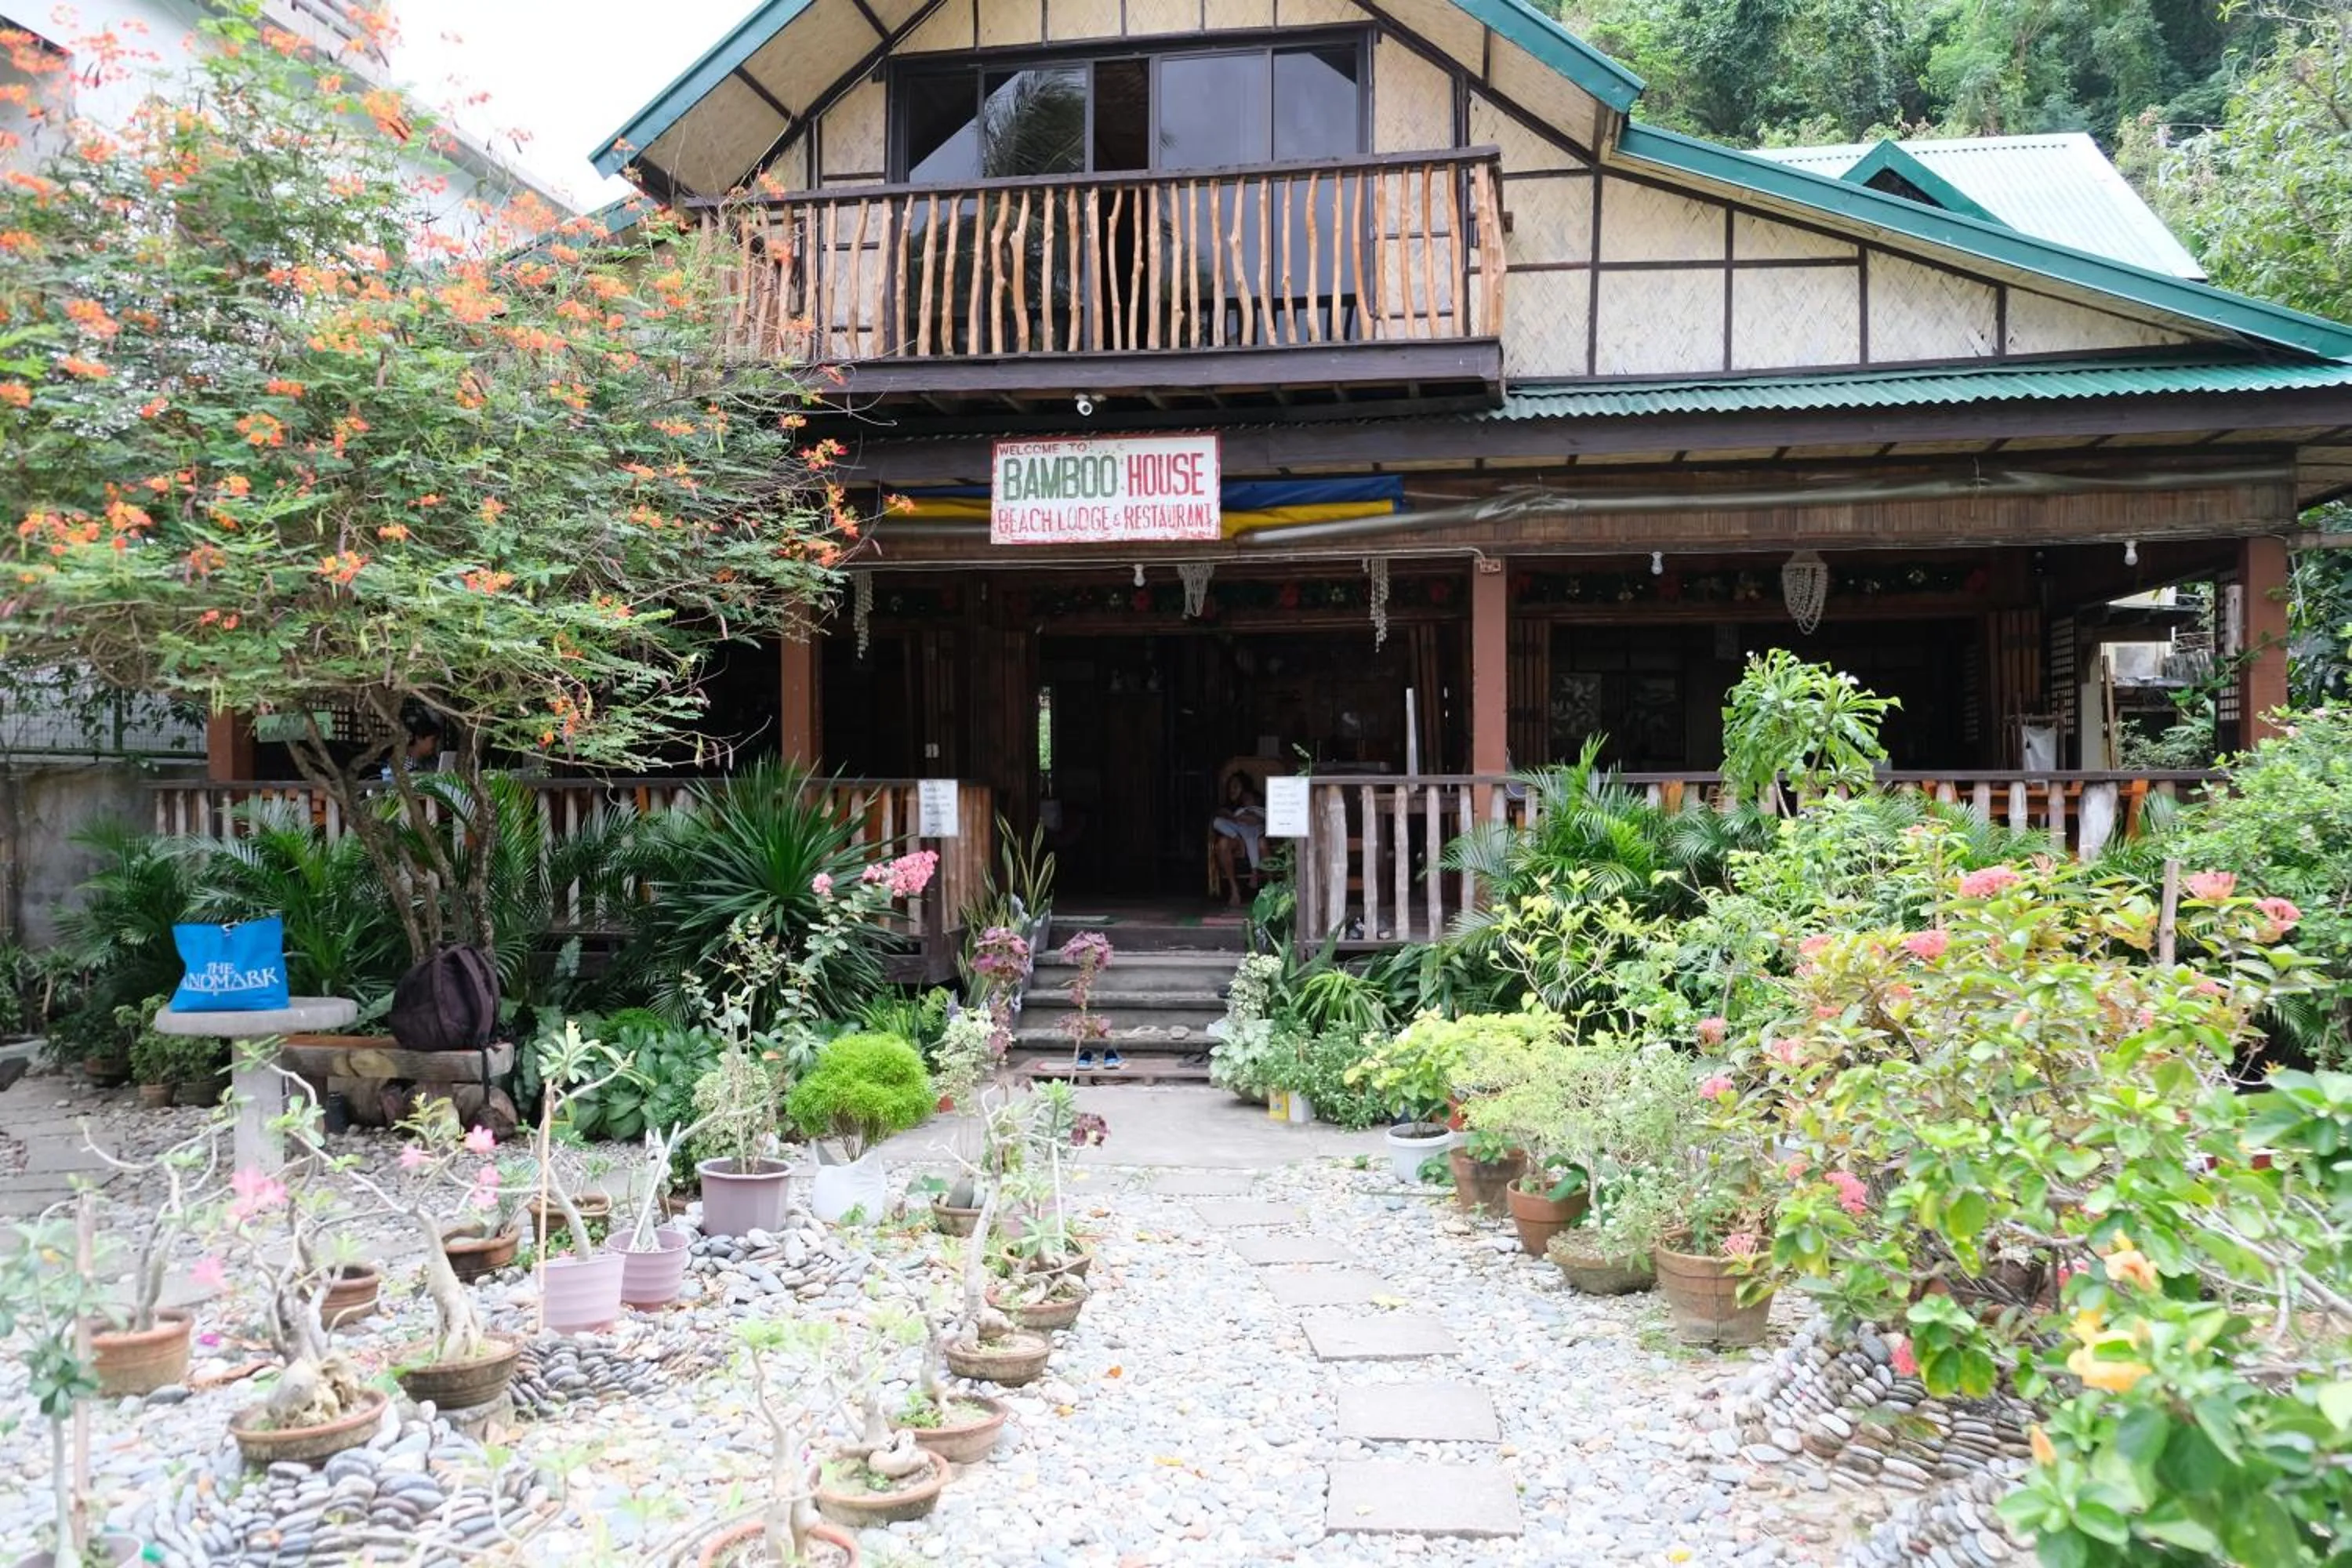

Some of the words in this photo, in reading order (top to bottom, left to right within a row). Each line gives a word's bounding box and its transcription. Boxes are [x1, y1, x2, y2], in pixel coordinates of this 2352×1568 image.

[998, 442, 1060, 456] WELCOME
[1003, 455, 1118, 500] BAMBOO
[1127, 452, 1205, 497] HOUSE
[997, 506, 1052, 534] BEACH
[1058, 506, 1111, 531] LODGE
[1123, 503, 1212, 531] RESTAURANT
[181, 967, 279, 993] ANDMARK
[206, 962, 234, 975] THE
